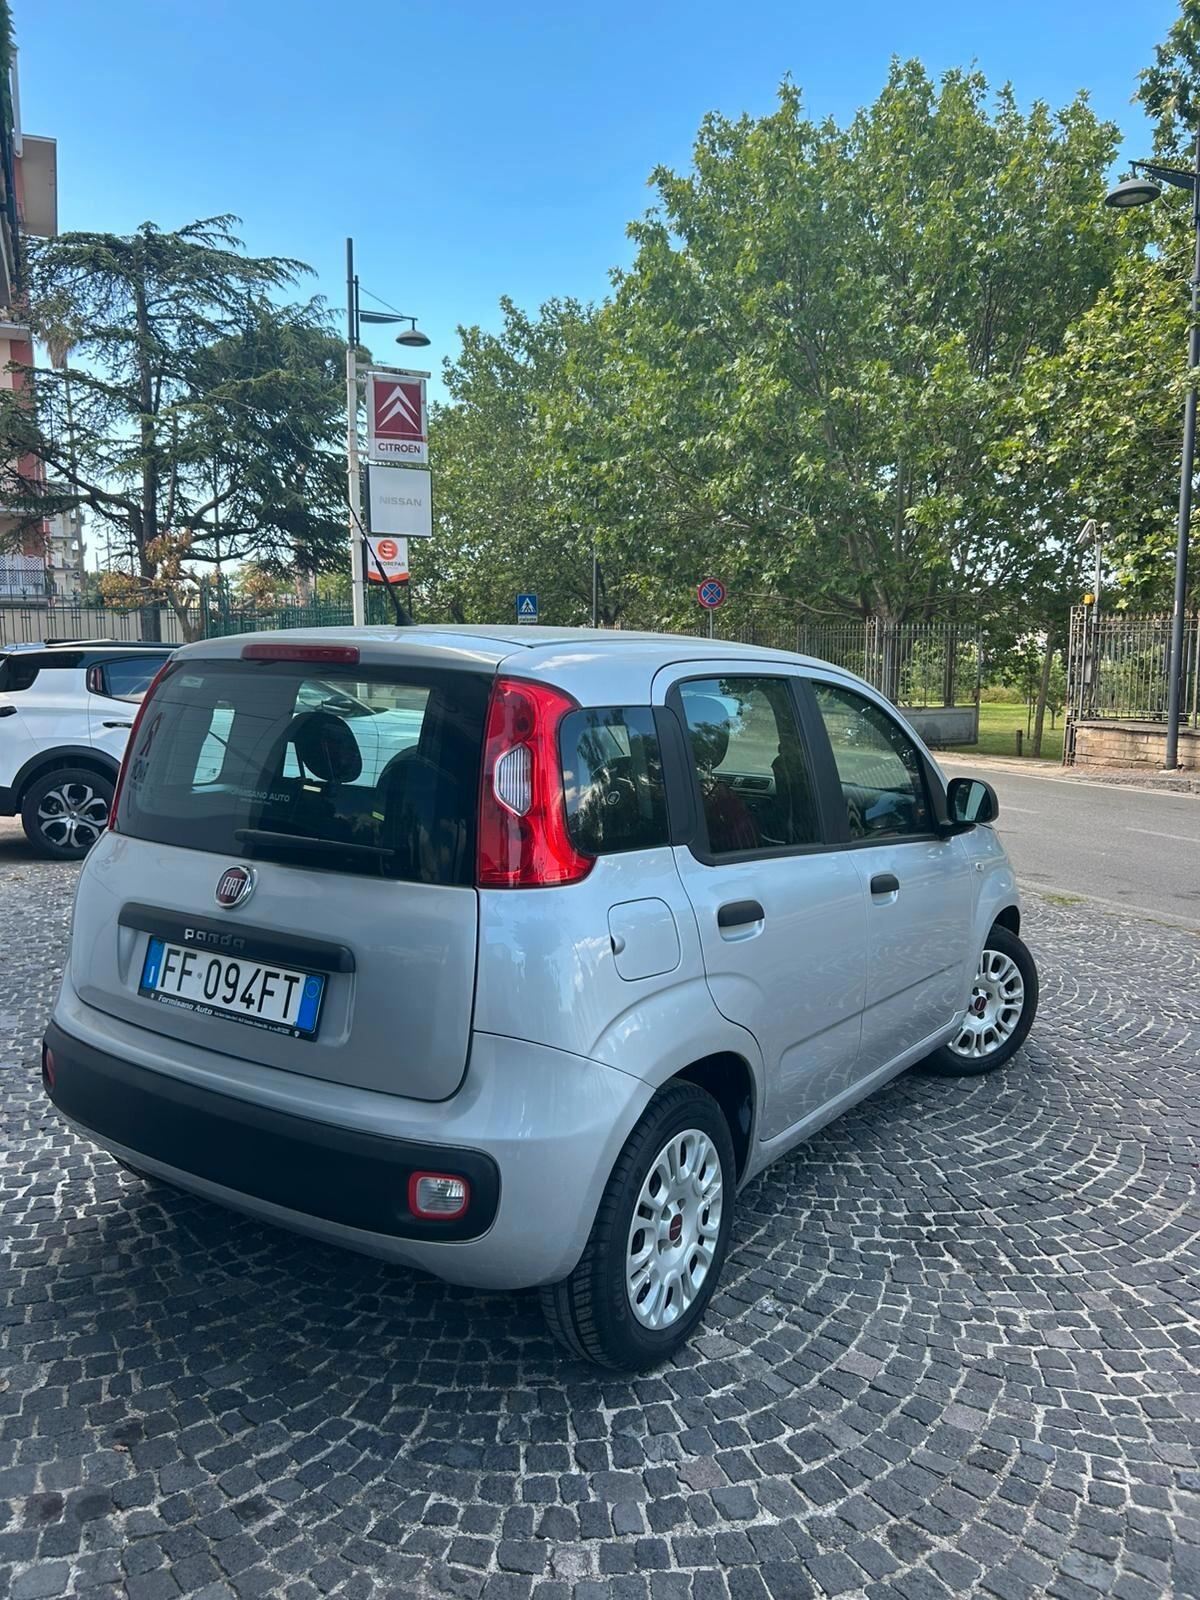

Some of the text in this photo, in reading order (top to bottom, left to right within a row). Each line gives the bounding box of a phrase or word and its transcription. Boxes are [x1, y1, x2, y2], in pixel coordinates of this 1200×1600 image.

[380, 495, 422, 507] NISSAN
[268, 791, 291, 803] AUTO
[220, 876, 246, 898] FIAT
[160, 947, 301, 1019] FF 094FT
[157, 994, 213, 1017] Formisano Auto
